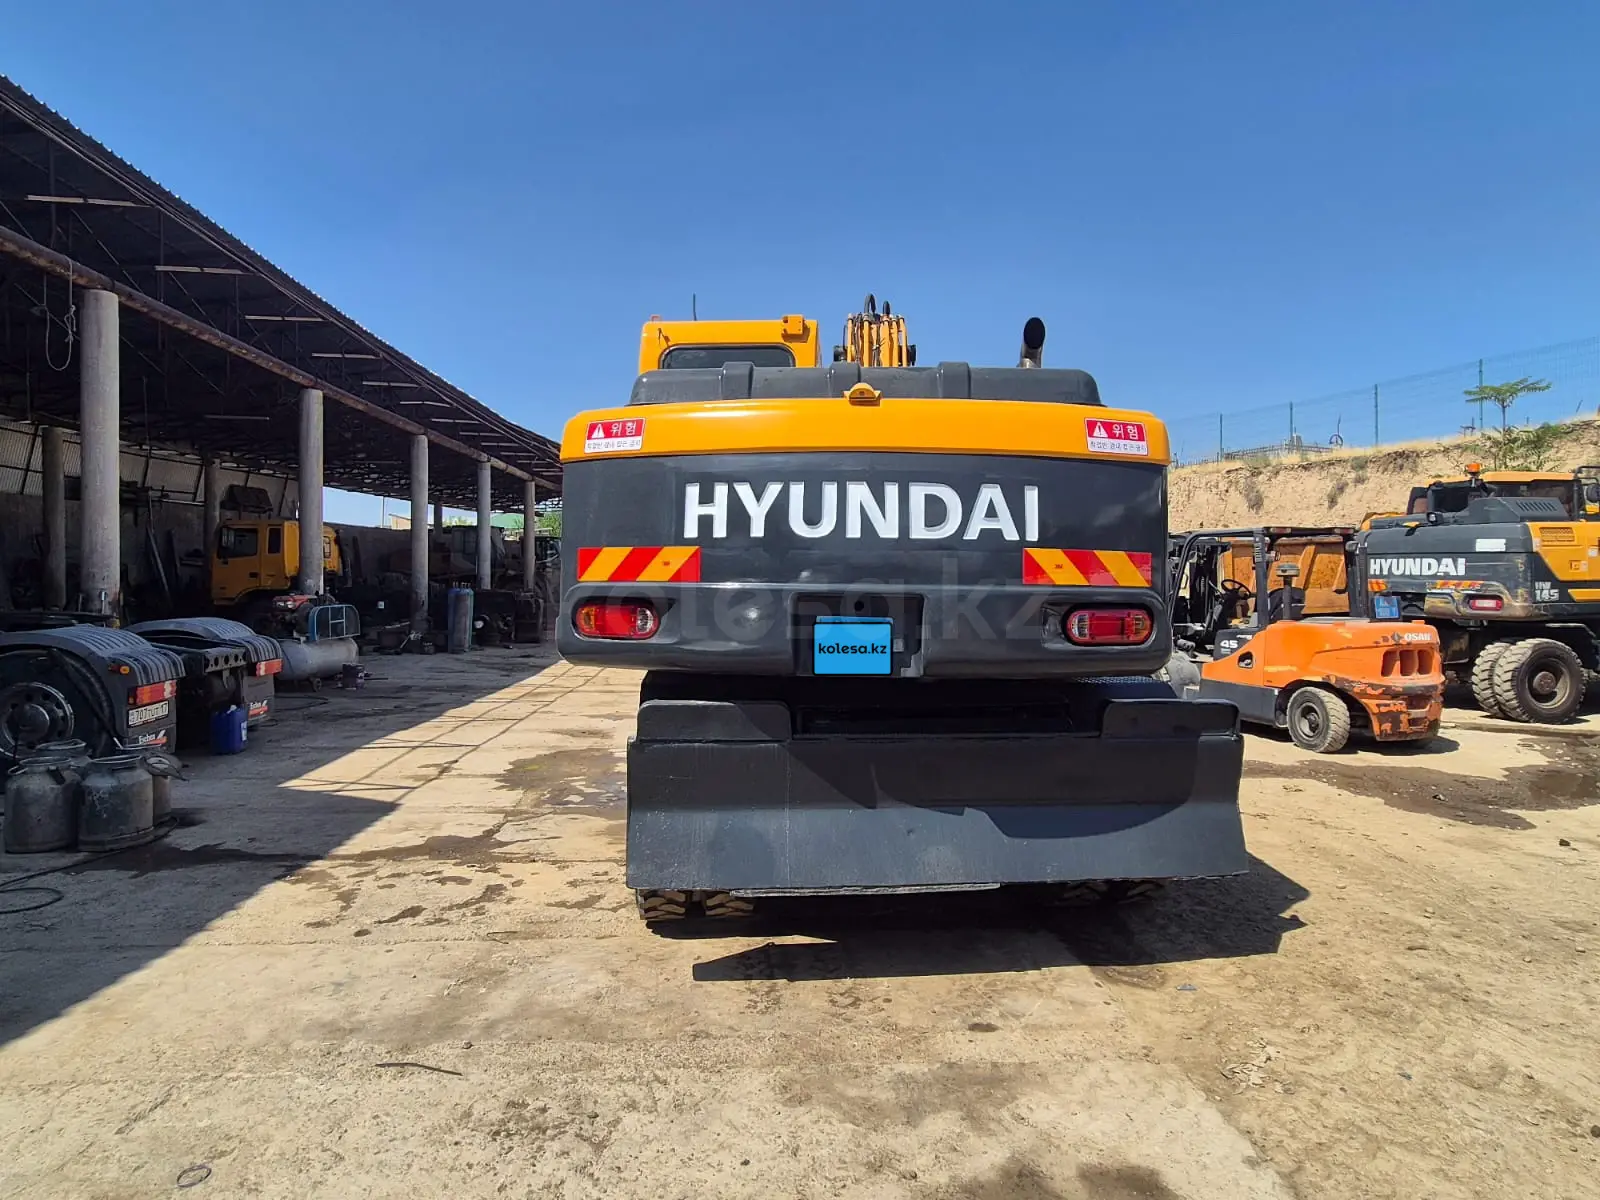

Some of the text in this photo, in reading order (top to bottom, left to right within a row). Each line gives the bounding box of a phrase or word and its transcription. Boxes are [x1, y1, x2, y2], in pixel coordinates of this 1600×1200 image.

[684, 481, 1039, 541] HYUNDAI
[1369, 557, 1466, 576] HYUNDAI
[1220, 639, 1238, 649] 45
